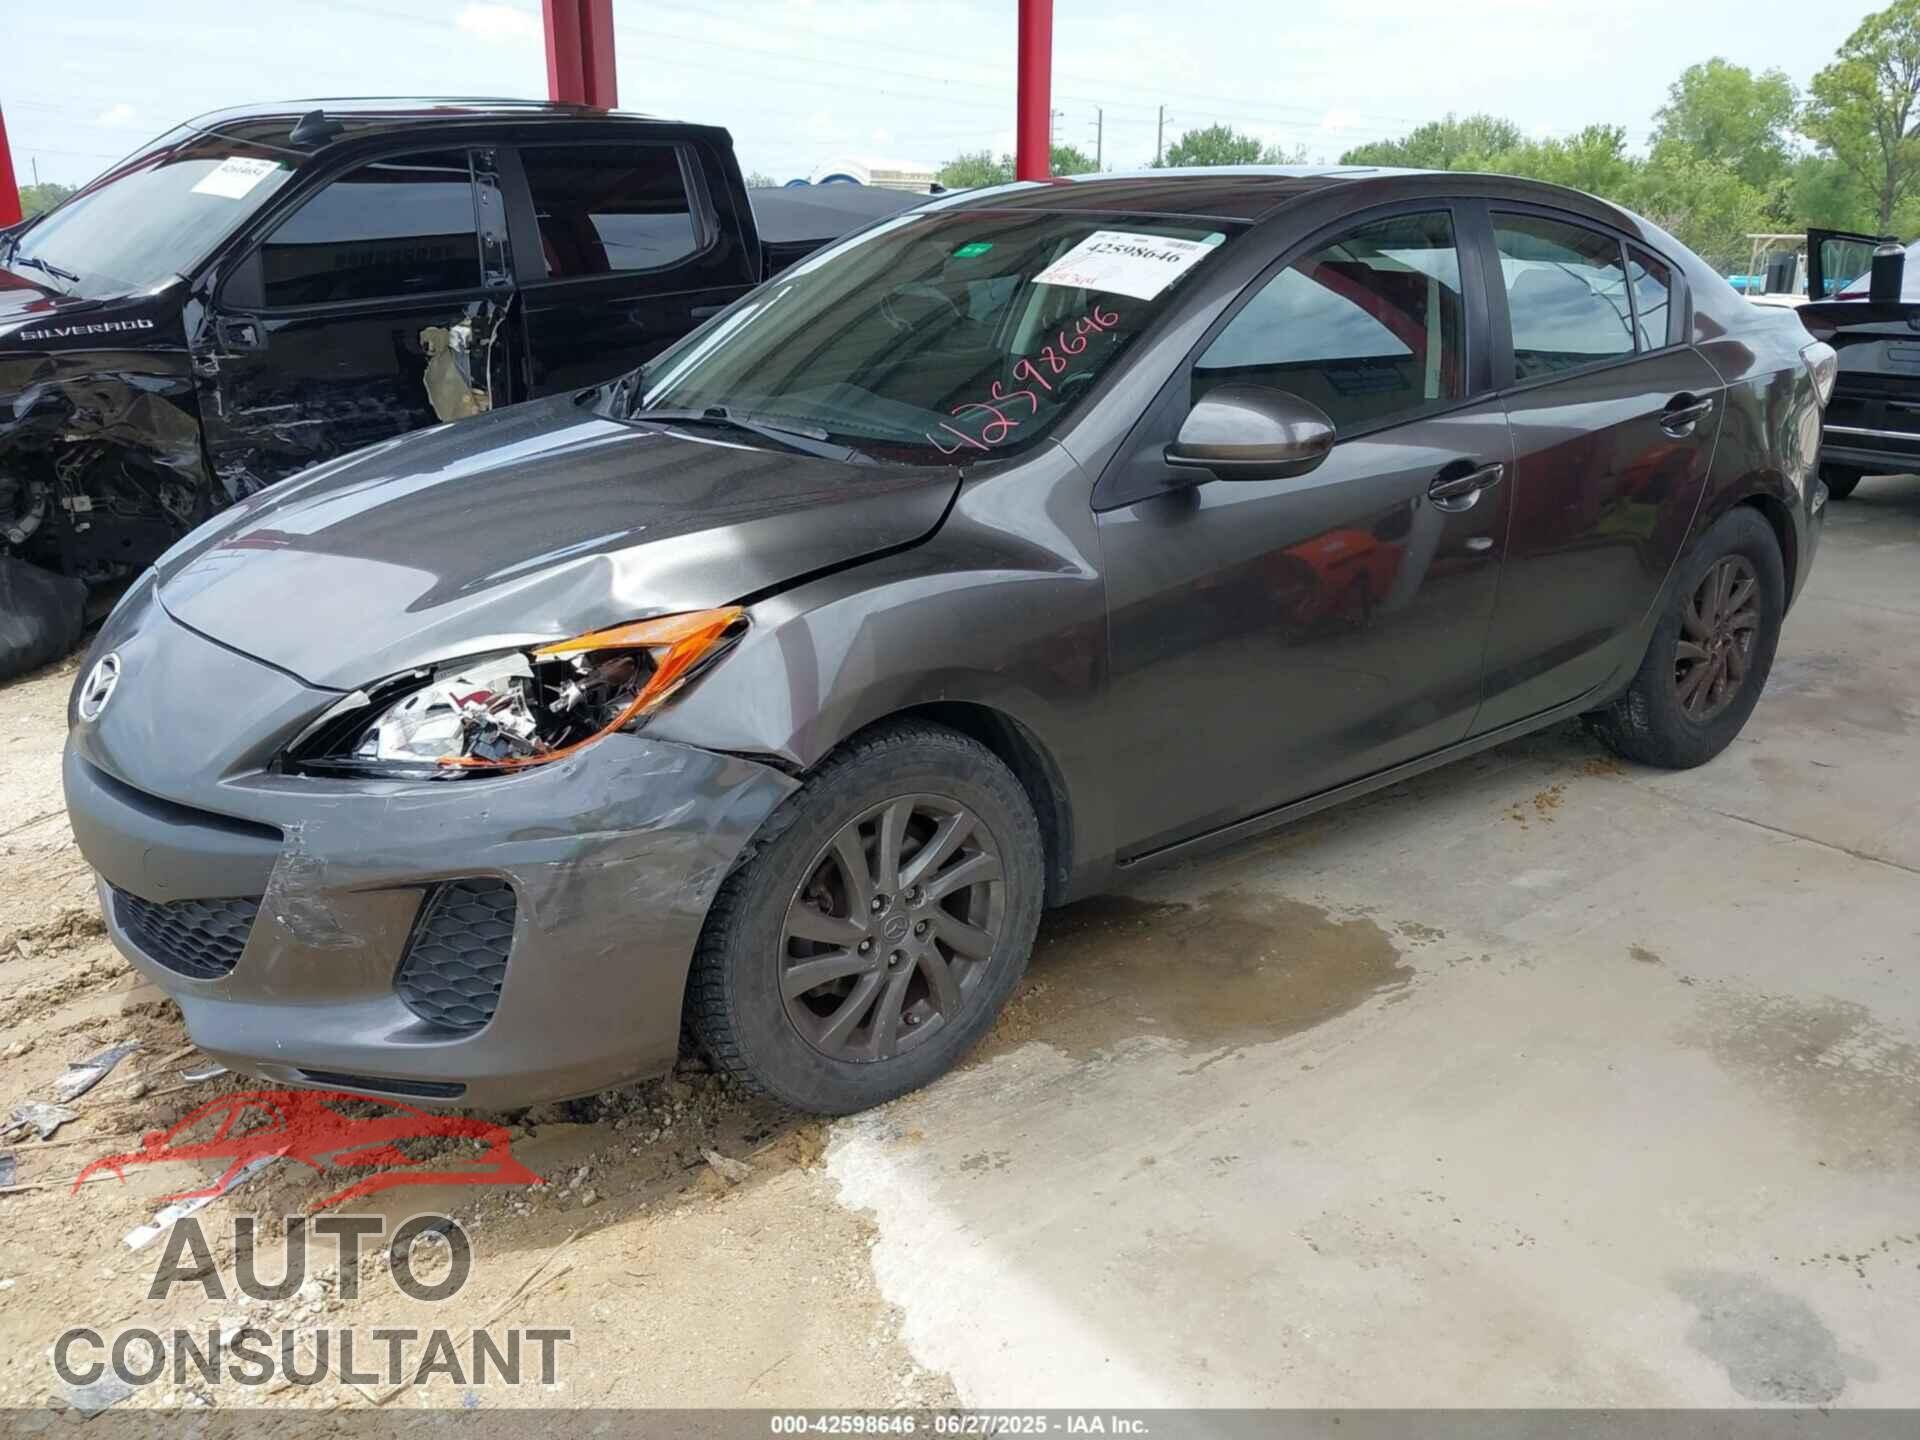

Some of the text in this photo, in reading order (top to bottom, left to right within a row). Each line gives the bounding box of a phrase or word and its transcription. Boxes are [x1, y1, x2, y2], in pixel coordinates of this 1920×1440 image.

[1087, 242, 1181, 264] 42598646
[19, 318, 155, 341] SILVERADO
[926, 305, 1119, 455] 42598646
